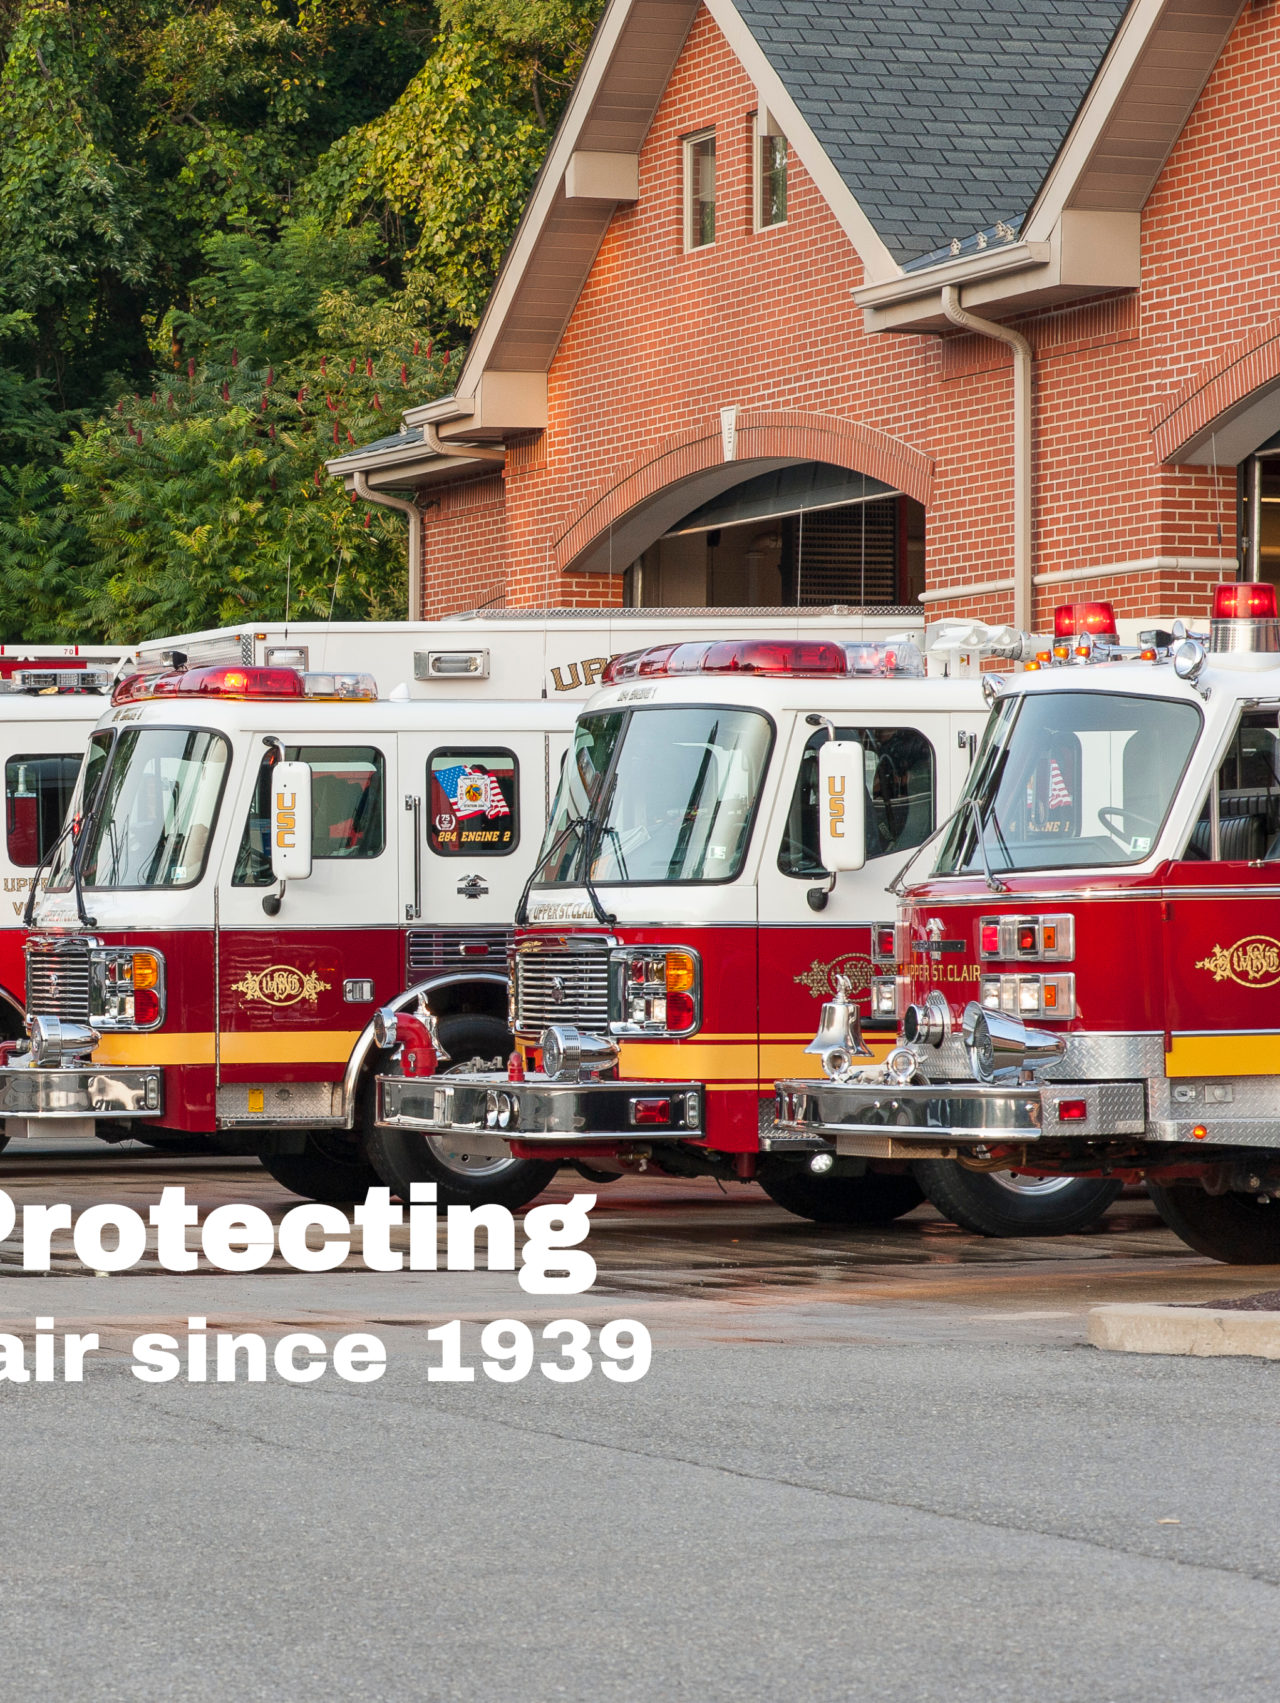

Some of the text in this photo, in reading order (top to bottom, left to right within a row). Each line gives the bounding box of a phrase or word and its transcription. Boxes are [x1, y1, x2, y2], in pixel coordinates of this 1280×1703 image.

[276, 792, 296, 848] USC
[828, 775, 846, 838] USC
[438, 831, 512, 842] 284 ENGINE 2
[932, 964, 946, 981] ST.
[947, 964, 980, 981] CLAIR
